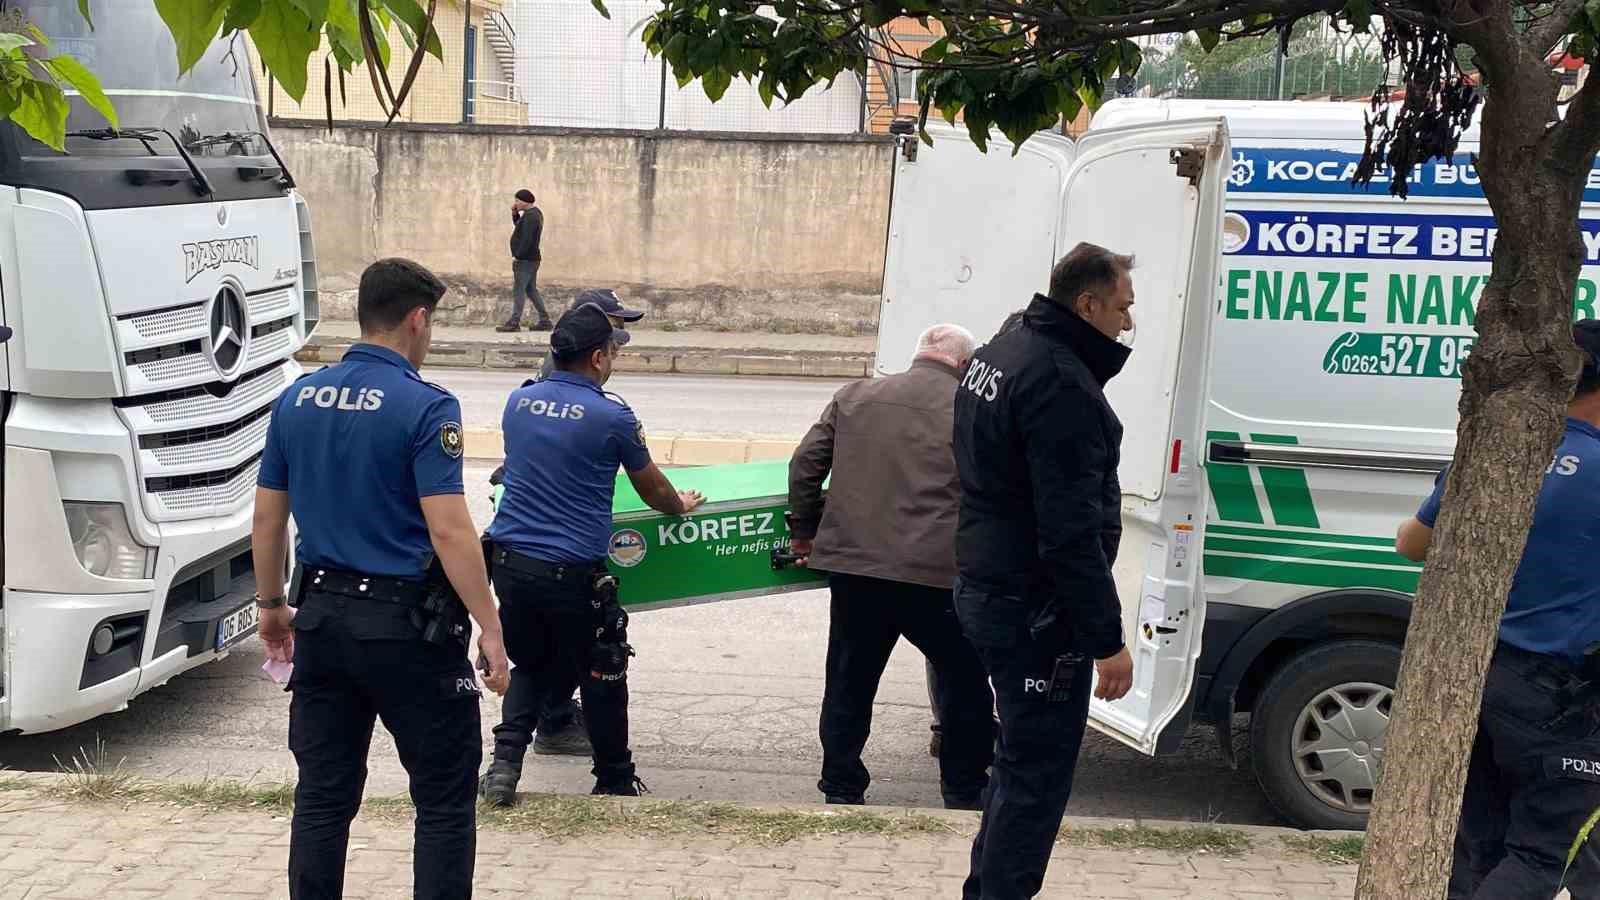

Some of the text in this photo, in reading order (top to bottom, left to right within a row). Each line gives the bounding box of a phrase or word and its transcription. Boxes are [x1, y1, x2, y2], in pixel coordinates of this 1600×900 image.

[1258, 216, 1418, 255] KÖRFEZ
[1218, 270, 1489, 326] ENAZE NAK
[1342, 355, 1378, 373] 0262
[1380, 336, 1431, 375] 527
[658, 512, 774, 546] KÖRFEZ
[741, 538, 769, 555] nefis
